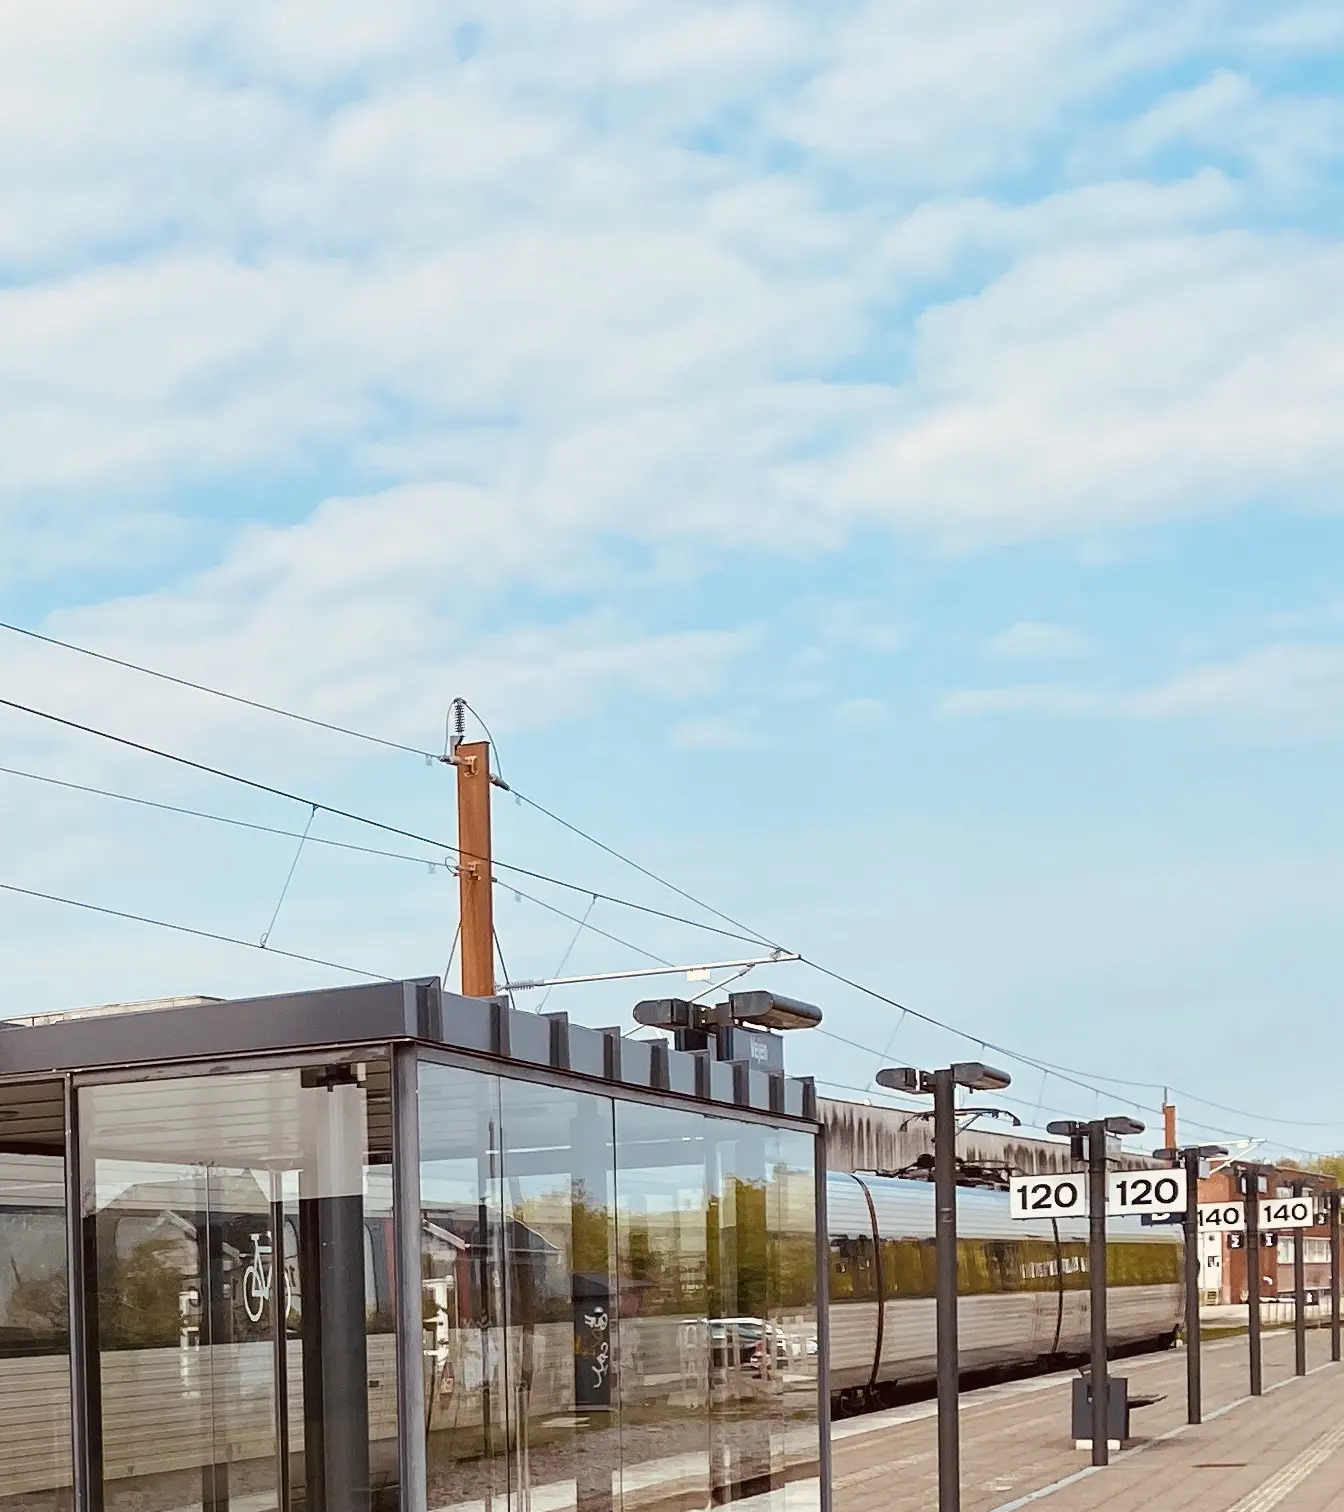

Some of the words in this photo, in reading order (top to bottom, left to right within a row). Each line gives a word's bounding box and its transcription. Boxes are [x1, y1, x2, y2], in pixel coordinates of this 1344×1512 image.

[1016, 1181, 1079, 1211] 120
[1115, 1177, 1180, 1207] 120
[1197, 1207, 1240, 1227] 140
[1263, 1203, 1309, 1223] 140
